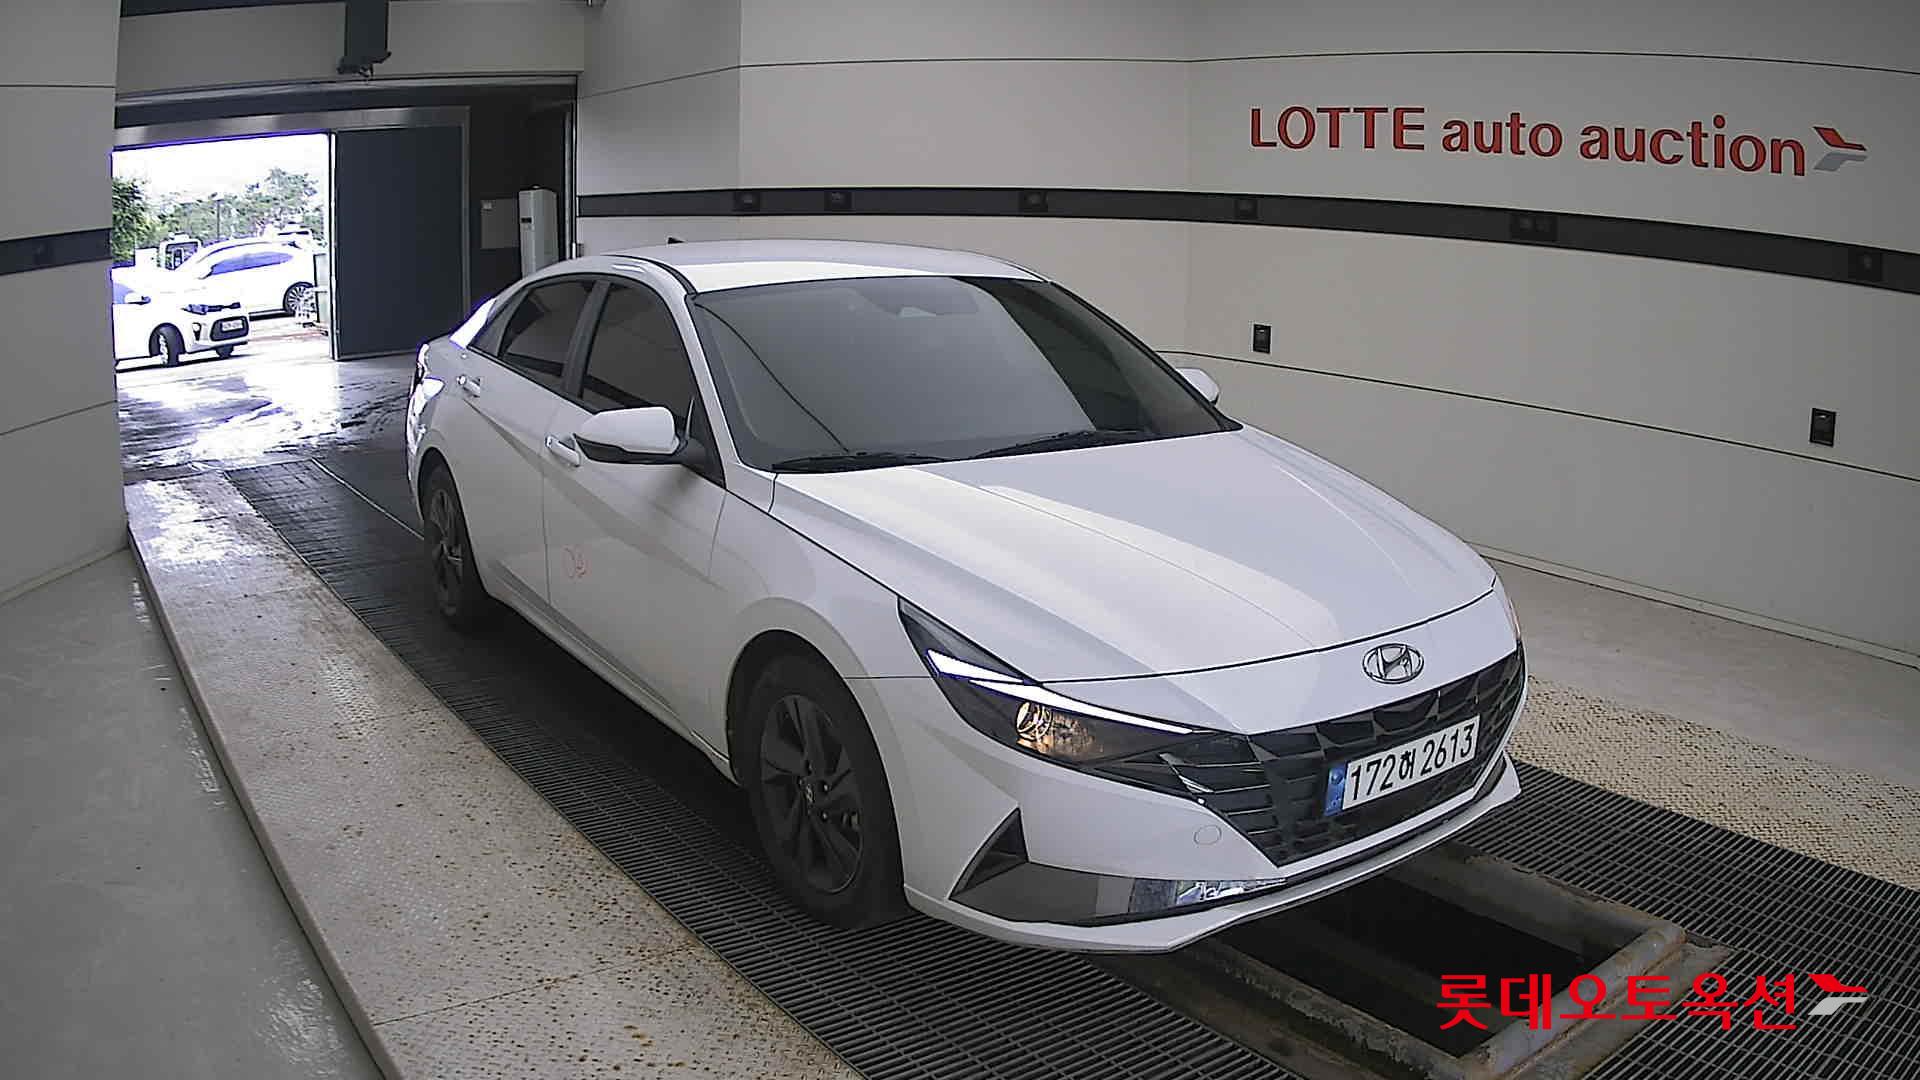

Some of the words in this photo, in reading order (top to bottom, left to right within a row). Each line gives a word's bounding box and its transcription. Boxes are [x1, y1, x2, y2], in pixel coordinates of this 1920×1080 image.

[1250, 106, 1425, 151] LOTTE
[1441, 112, 1563, 158] auto
[1579, 114, 1806, 177] auction
[1350, 748, 1417, 801] 172허
[1420, 723, 1475, 777] 2613
